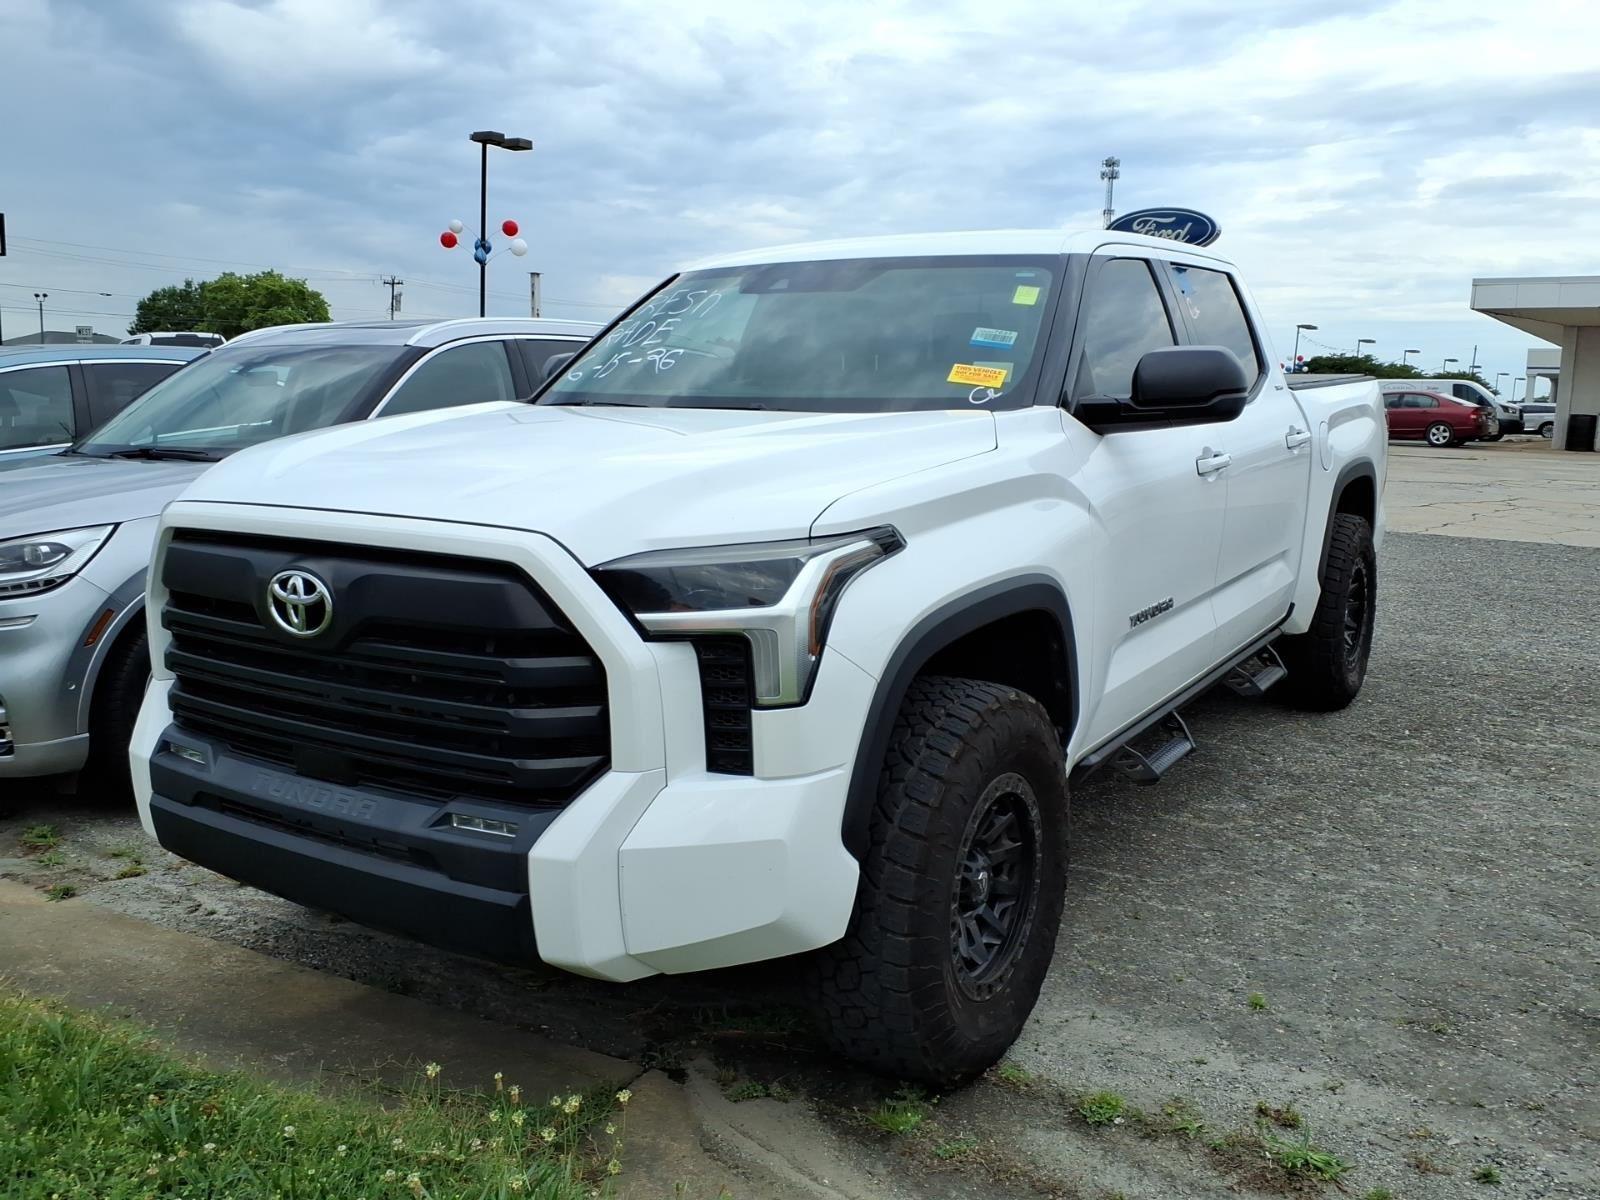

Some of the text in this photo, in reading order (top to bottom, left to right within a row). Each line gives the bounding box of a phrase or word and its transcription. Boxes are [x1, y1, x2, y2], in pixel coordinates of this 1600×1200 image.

[1132, 216, 1192, 243] Ford
[78, 328, 91, 336] WEST
[973, 367, 1002, 376] VEHICLE
[251, 770, 378, 820] TUNDRA
